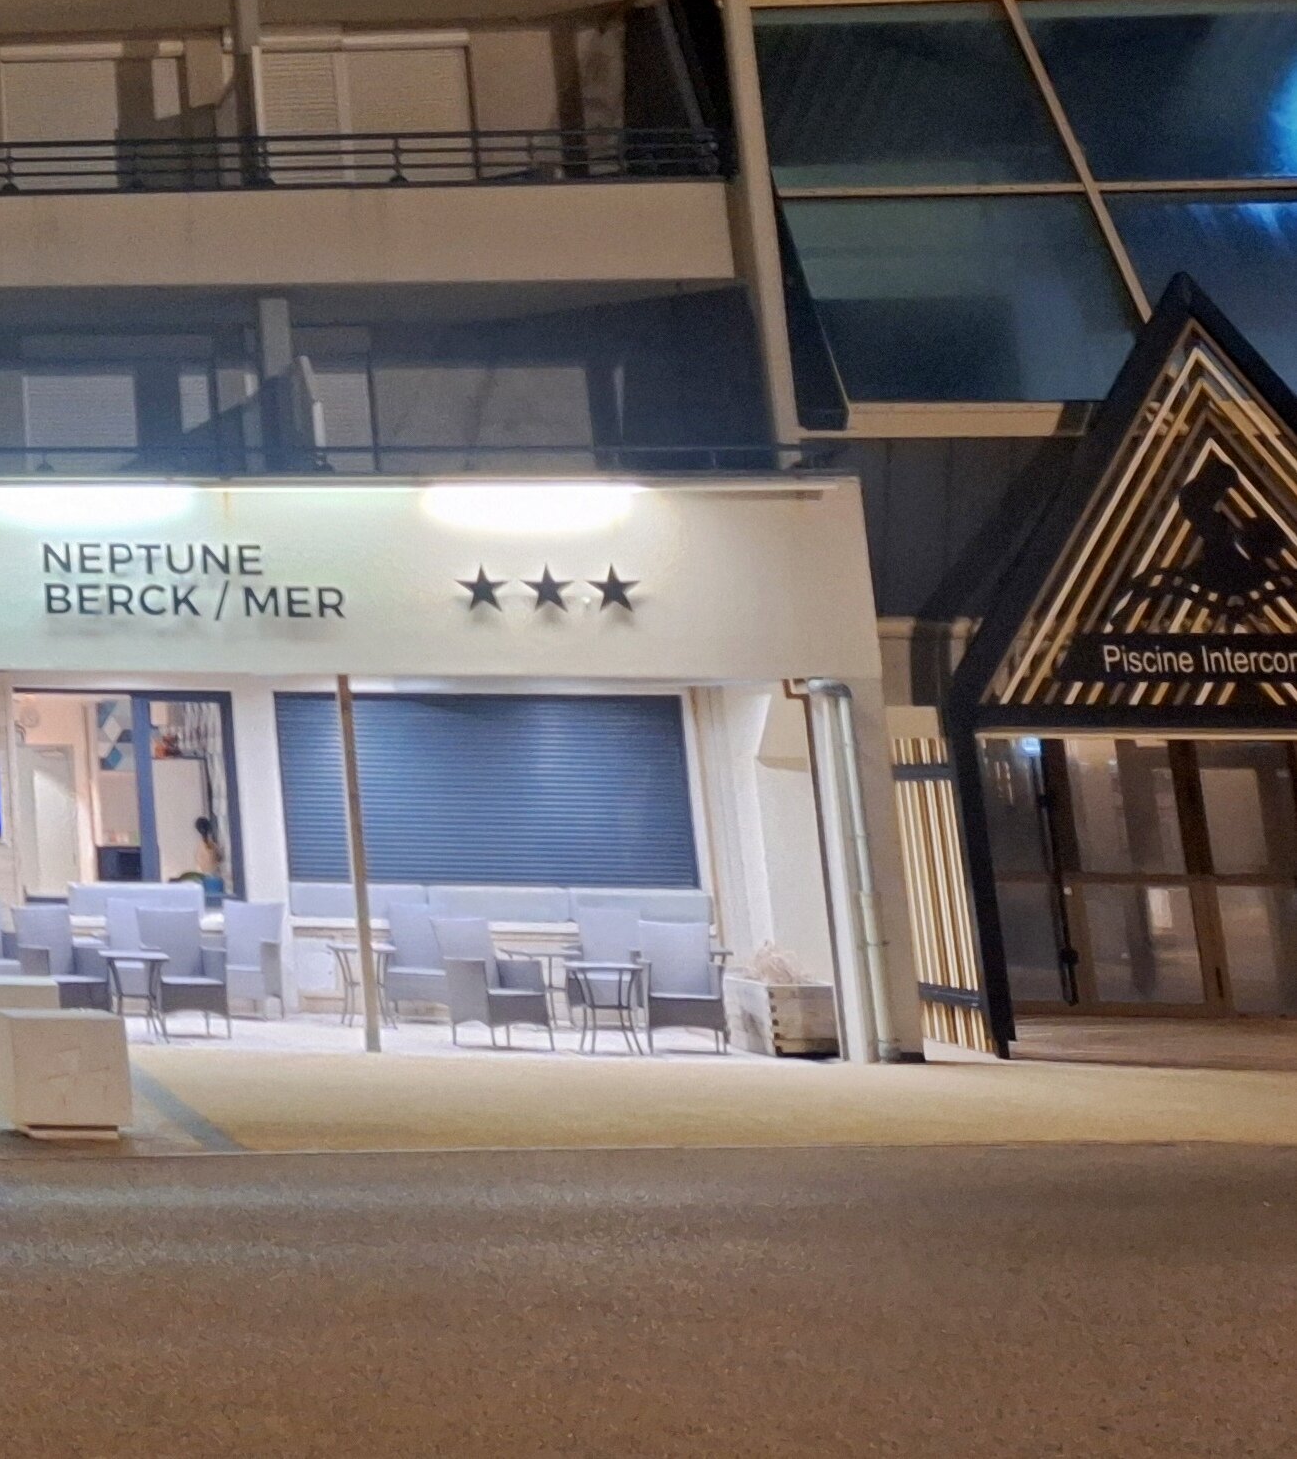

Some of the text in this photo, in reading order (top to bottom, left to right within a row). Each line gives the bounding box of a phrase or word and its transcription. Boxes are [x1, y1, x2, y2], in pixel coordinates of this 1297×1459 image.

[42, 542, 264, 576] NEPTUNE
[43, 582, 202, 617] BERCK
[243, 585, 346, 620] MER
[1102, 644, 1195, 674] Piscine
